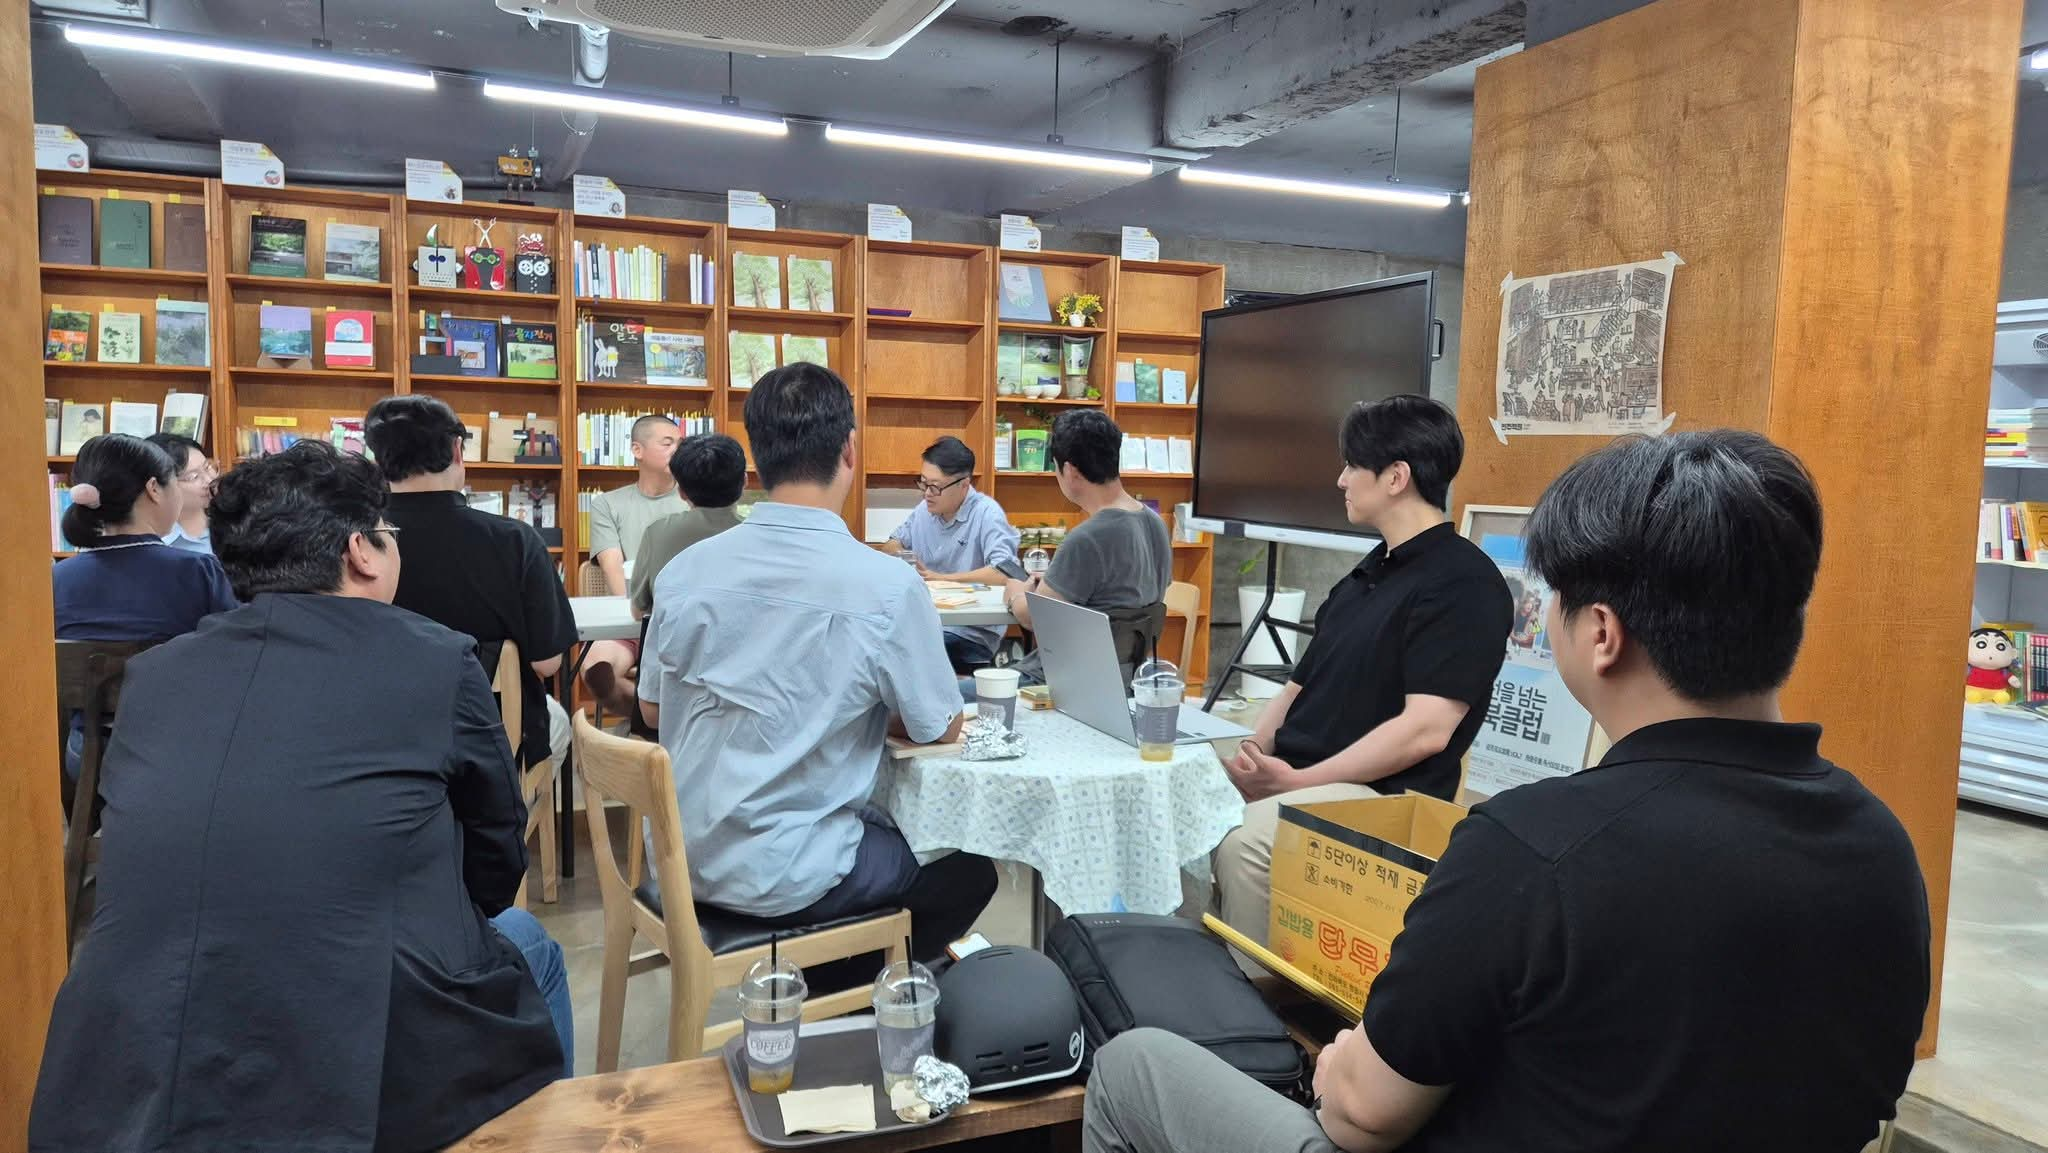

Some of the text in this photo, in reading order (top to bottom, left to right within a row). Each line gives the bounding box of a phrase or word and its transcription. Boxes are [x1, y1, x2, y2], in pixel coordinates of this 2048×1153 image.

[609, 323, 639, 342] 알도
[1518, 686, 1547, 712] 넘는
[1484, 703, 1543, 742] 북클럽
[1323, 874, 1353, 896] 소비기한
[1325, 847, 1424, 896] 5단이상 적재 금
[1277, 904, 1390, 976] 김밥용 단무
